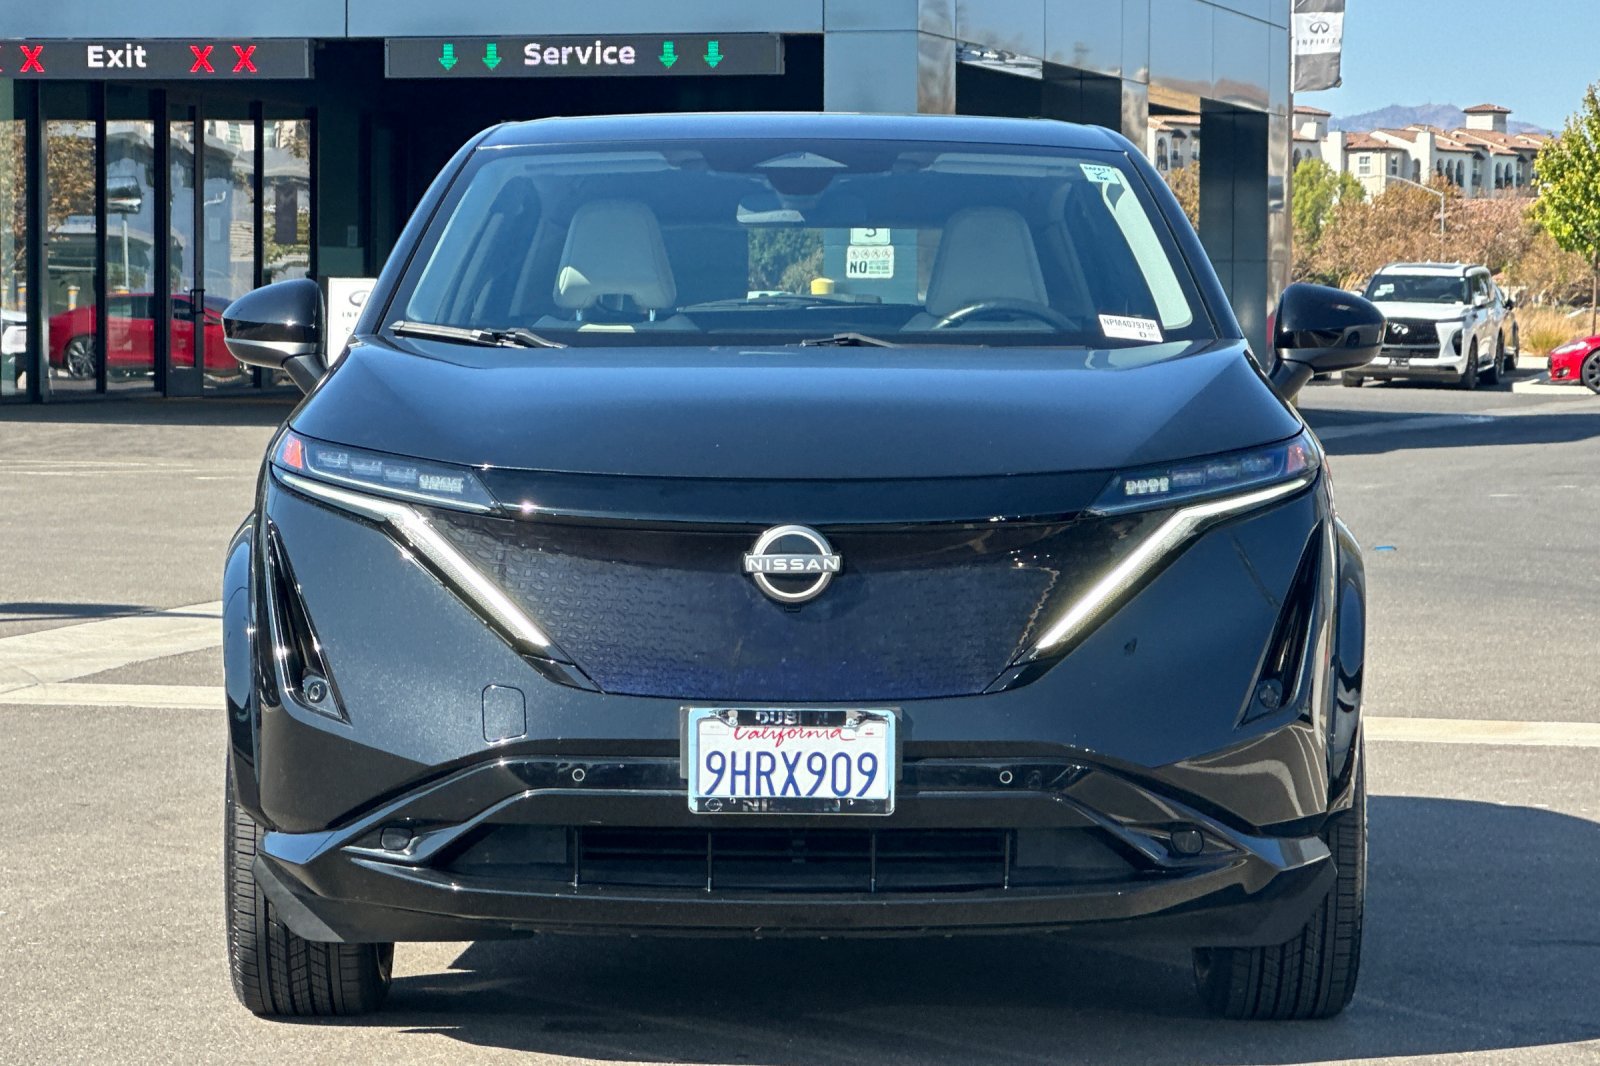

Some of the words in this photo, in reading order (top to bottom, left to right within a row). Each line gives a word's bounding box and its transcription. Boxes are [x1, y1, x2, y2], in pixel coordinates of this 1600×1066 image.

[86, 43, 147, 68] Exit
[523, 40, 636, 66] Service
[849, 260, 868, 274] NO
[747, 557, 838, 571] NISSAN
[733, 726, 857, 748] California
[704, 750, 879, 798] 9HRX909
